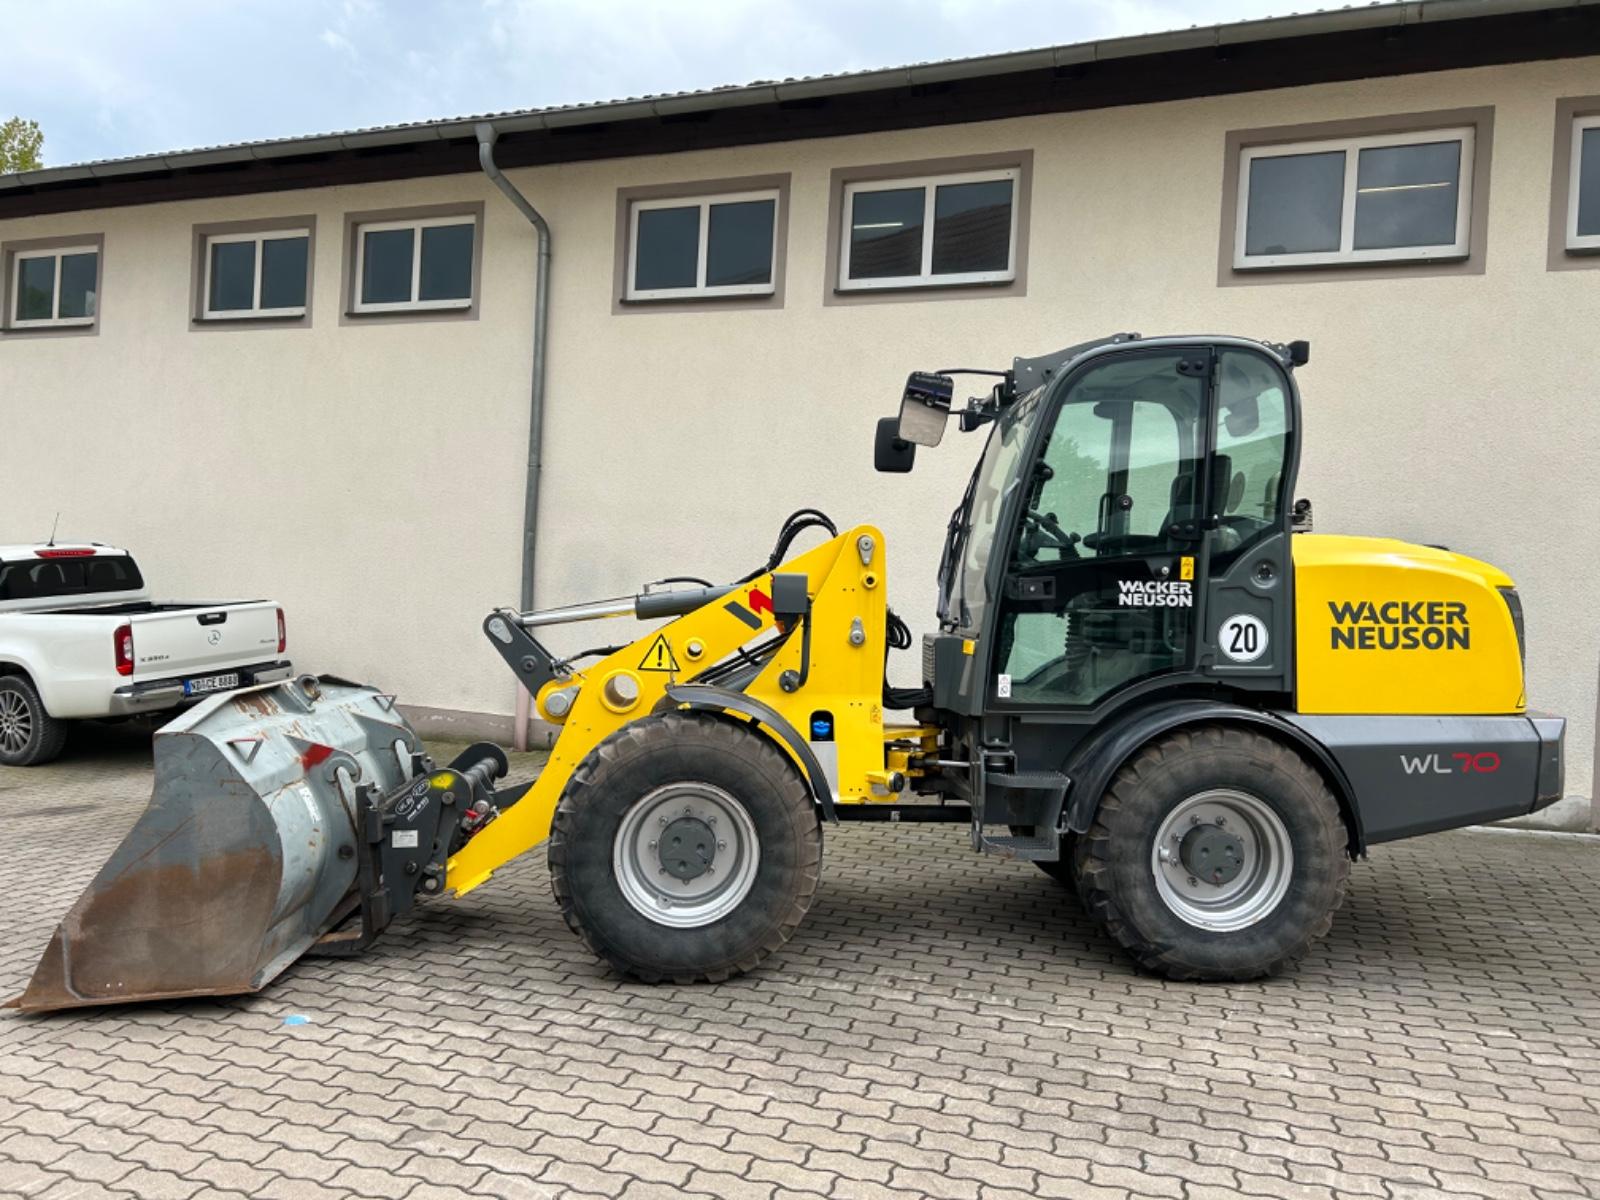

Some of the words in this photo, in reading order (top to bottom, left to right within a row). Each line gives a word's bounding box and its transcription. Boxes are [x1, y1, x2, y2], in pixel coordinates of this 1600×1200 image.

[1118, 580, 1193, 595] WACKER
[1118, 593, 1193, 607] NEUSON
[1328, 601, 1470, 625] WACKER
[1229, 623, 1258, 653] 20
[1330, 626, 1470, 650] NEUSON
[1399, 751, 1502, 775] WL70
